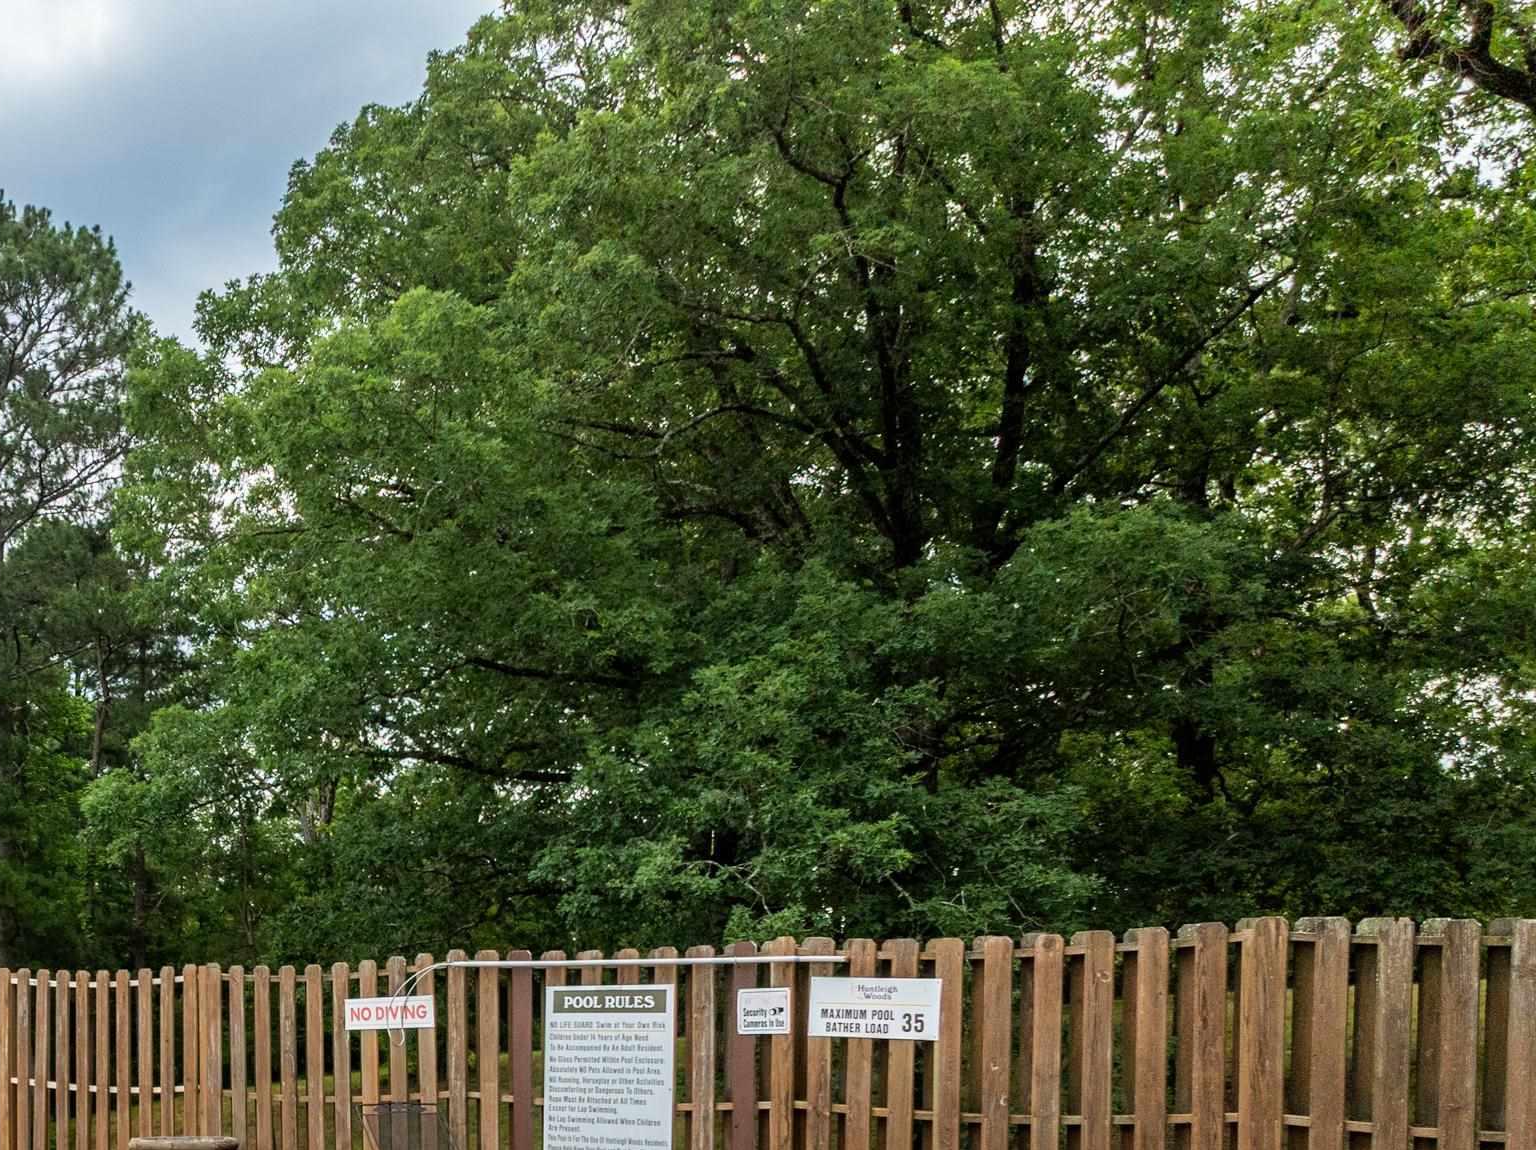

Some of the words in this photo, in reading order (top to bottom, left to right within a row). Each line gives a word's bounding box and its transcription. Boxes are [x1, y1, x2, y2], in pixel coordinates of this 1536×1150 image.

[857, 984, 898, 993] Huntleigh
[564, 996, 602, 1009] POOL
[605, 995, 655, 1008] RULES
[350, 1007, 372, 1022] NO
[376, 1004, 427, 1020] DIVING
[743, 1008, 767, 1018] Security
[821, 1008, 867, 1020] MAXIMUM
[871, 1010, 895, 1021] POOL
[825, 1022, 861, 1033] BATHER
[866, 1023, 889, 1034] LOAD
[902, 1013, 924, 1033] 35
